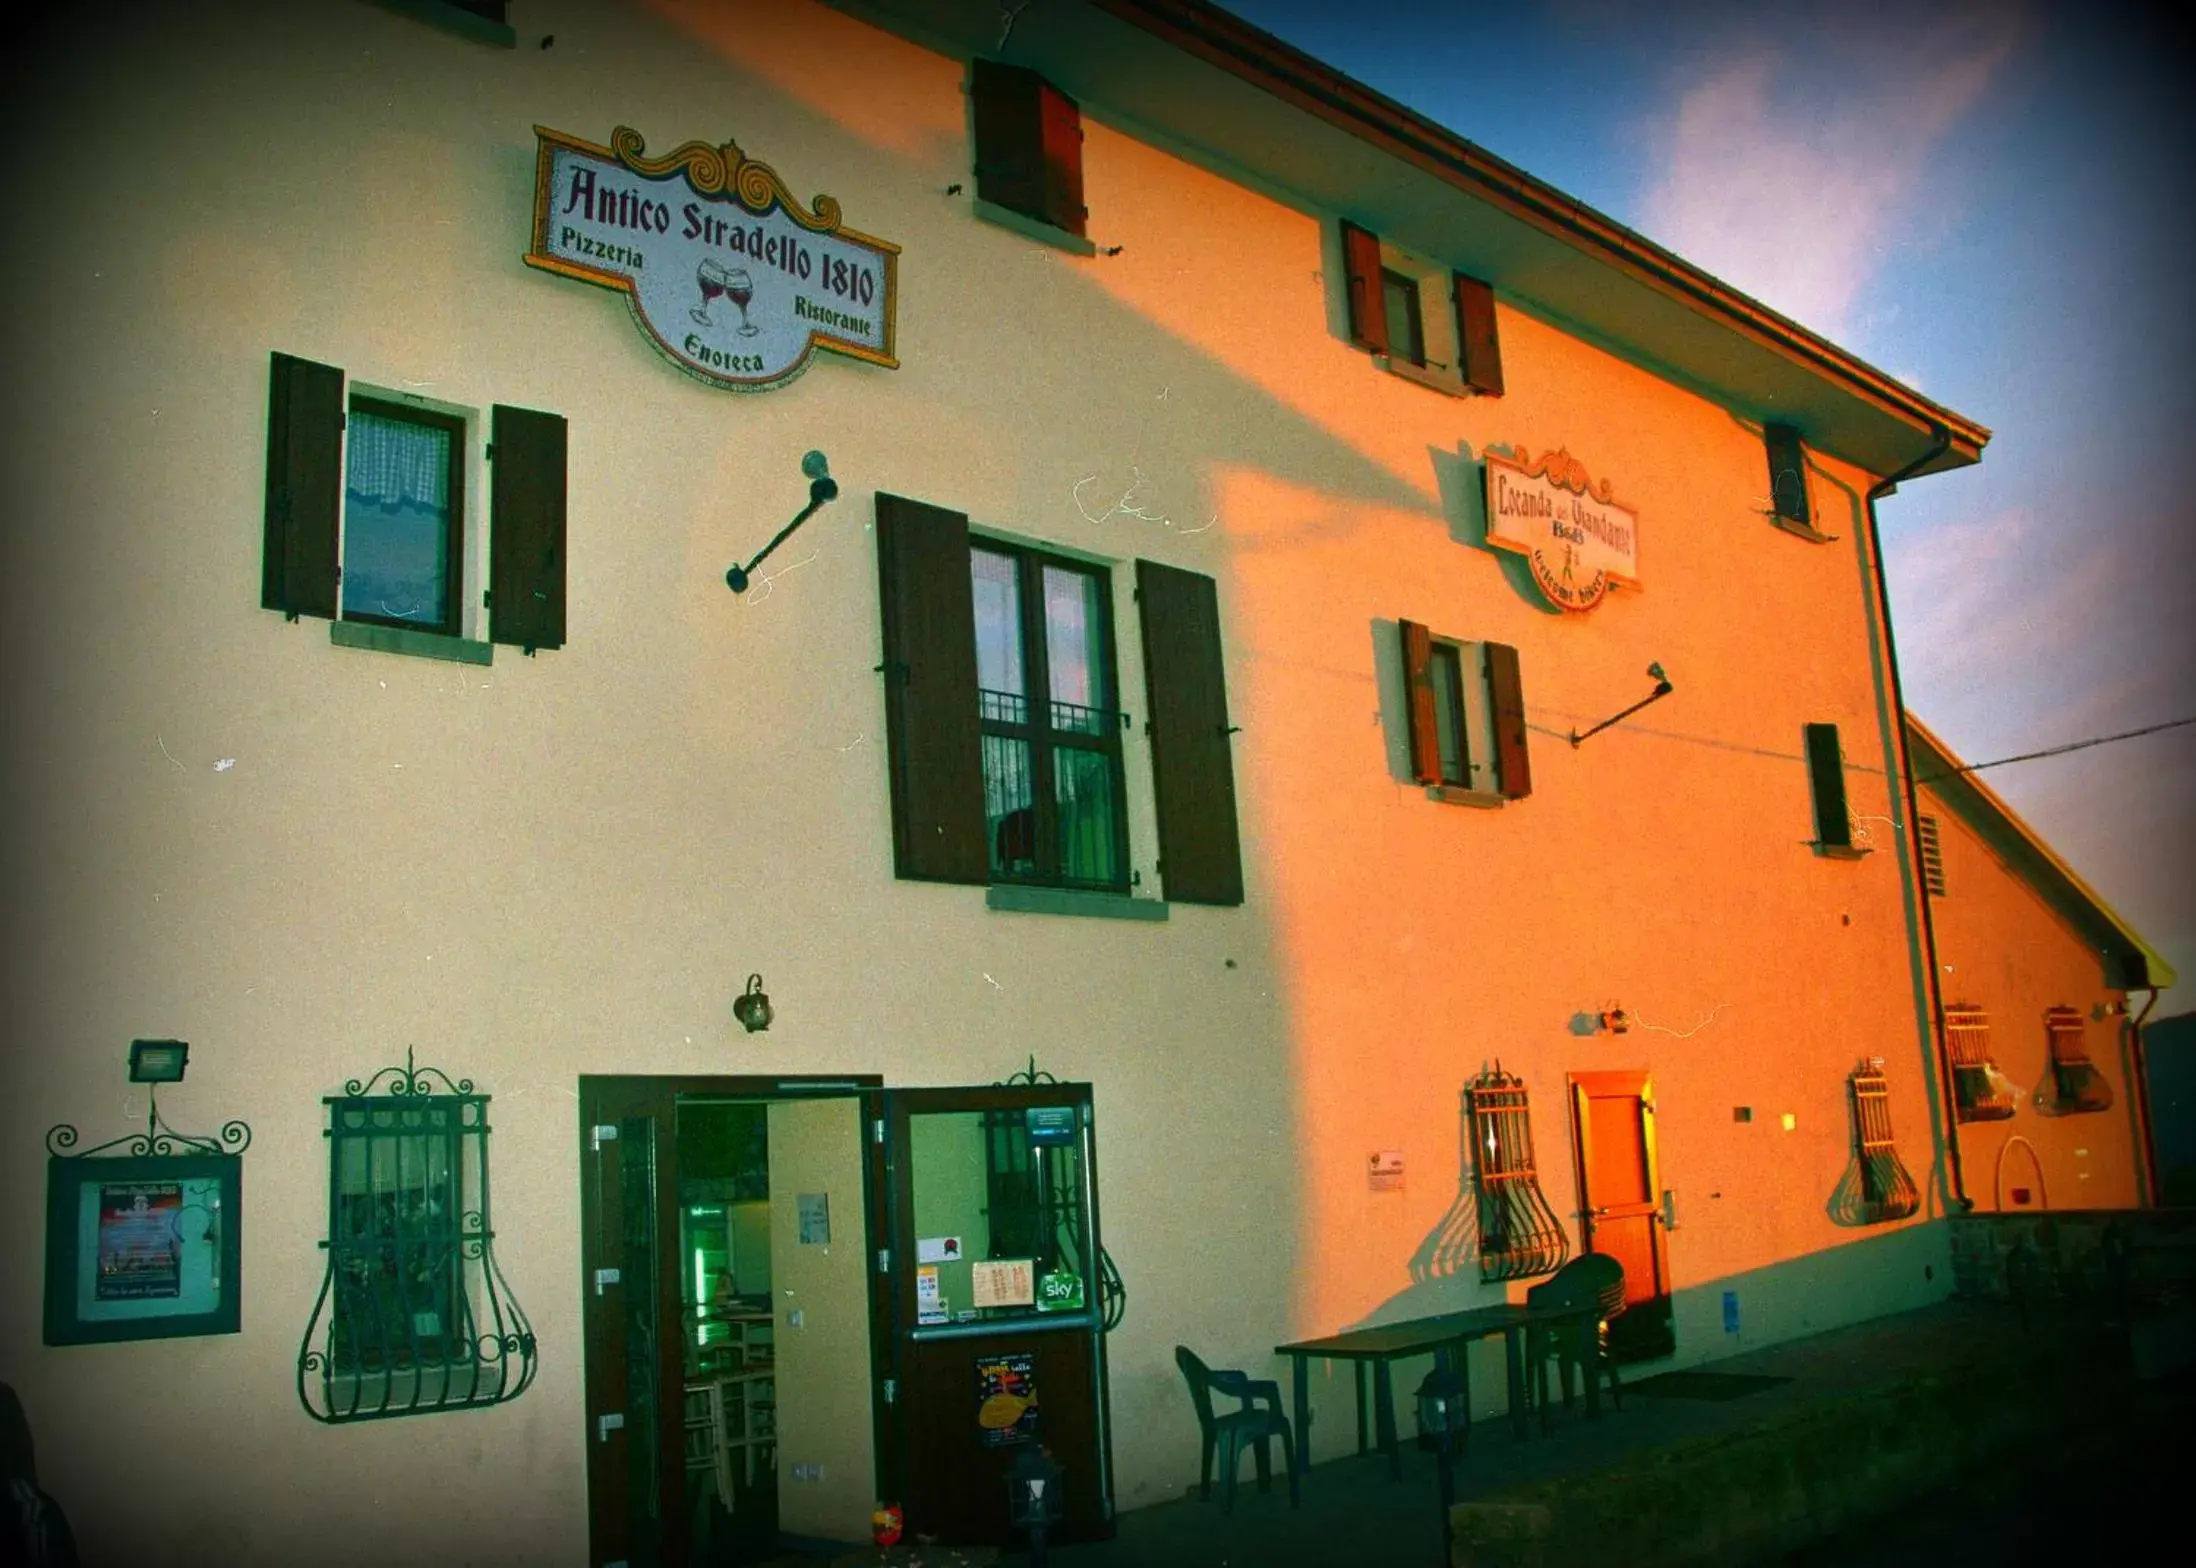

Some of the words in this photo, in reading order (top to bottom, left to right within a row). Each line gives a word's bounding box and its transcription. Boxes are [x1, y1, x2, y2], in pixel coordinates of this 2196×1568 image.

[562, 165, 670, 234] Antico
[682, 202, 812, 281] Stradello
[822, 253, 874, 307] 1810
[562, 226, 643, 269] Pizzeria
[794, 294, 871, 336] Ristorante
[684, 333, 765, 372] Enoteca
[1498, 474, 1553, 519] Locanda
[1045, 1279, 1073, 1299] sky
